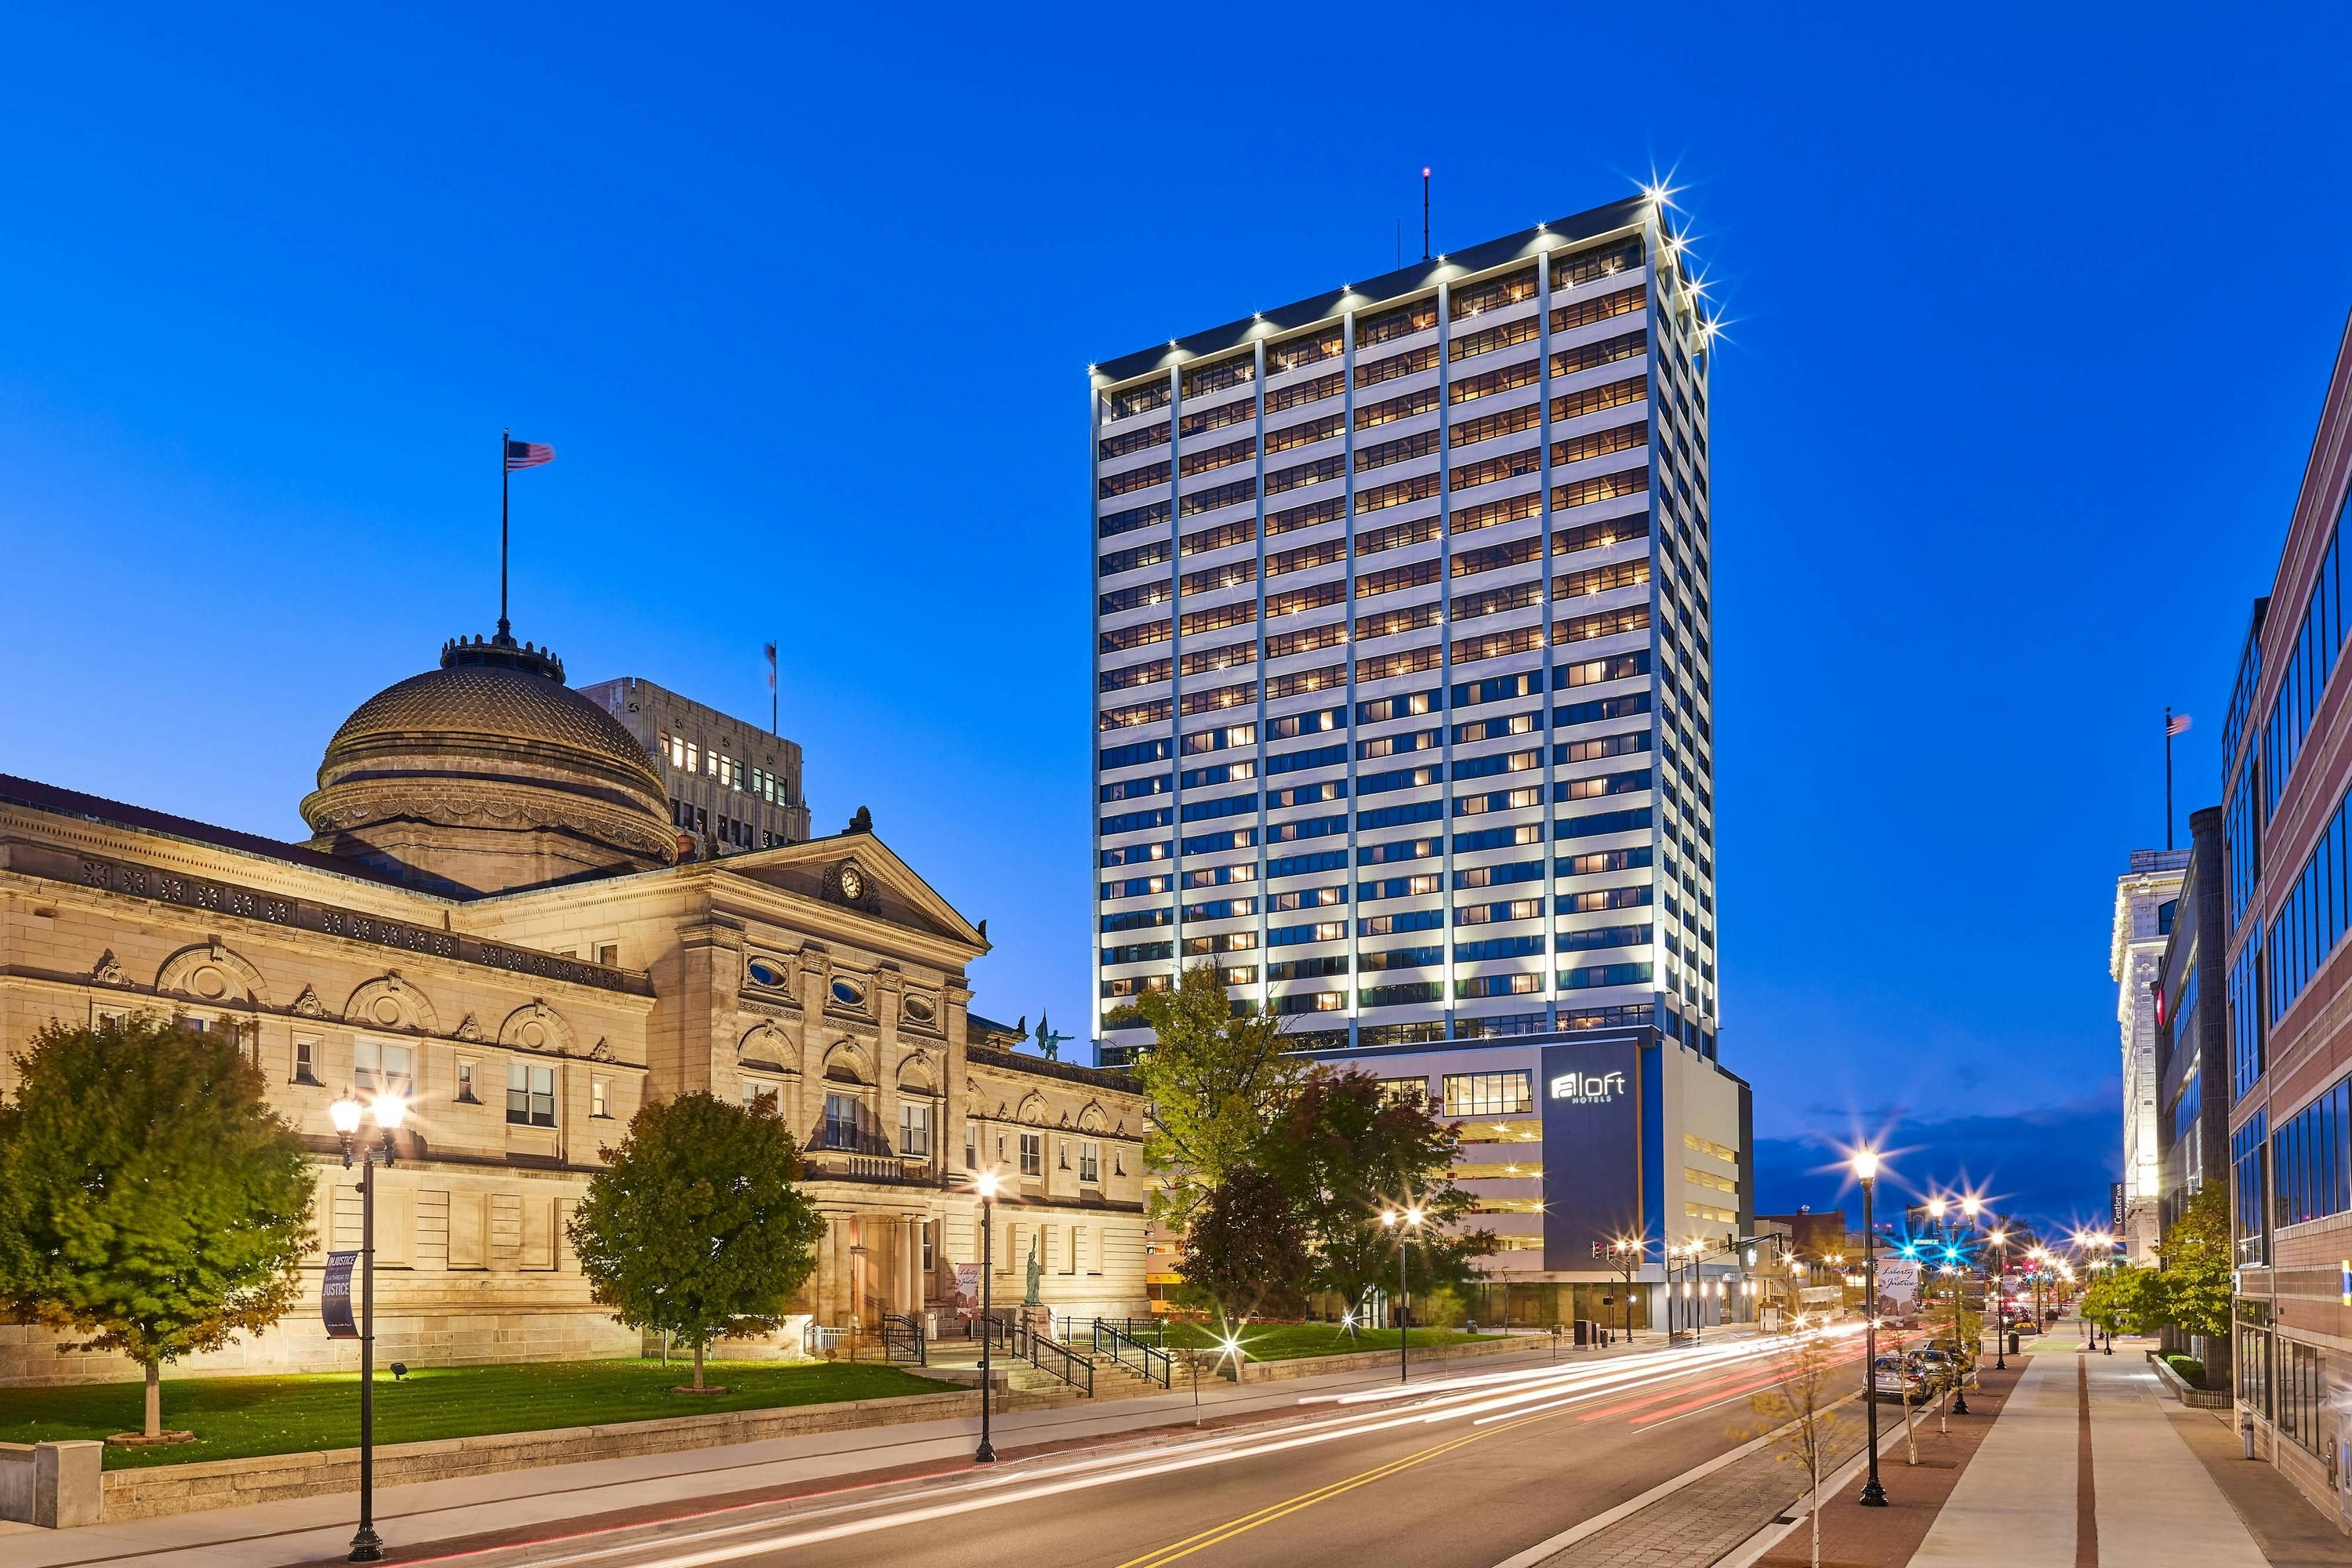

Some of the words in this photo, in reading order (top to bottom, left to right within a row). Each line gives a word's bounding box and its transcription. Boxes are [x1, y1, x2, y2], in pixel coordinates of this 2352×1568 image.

[1552, 1072, 1625, 1098] aloft
[1572, 1095, 1612, 1104] HOTELS
[2114, 1196, 2122, 1225] Centier
[328, 1255, 356, 1266] INJUSTICE
[1882, 1267, 1914, 1279] Liberty
[322, 1282, 350, 1296] JUSTICE
[1886, 1278, 1917, 1289] Justice
